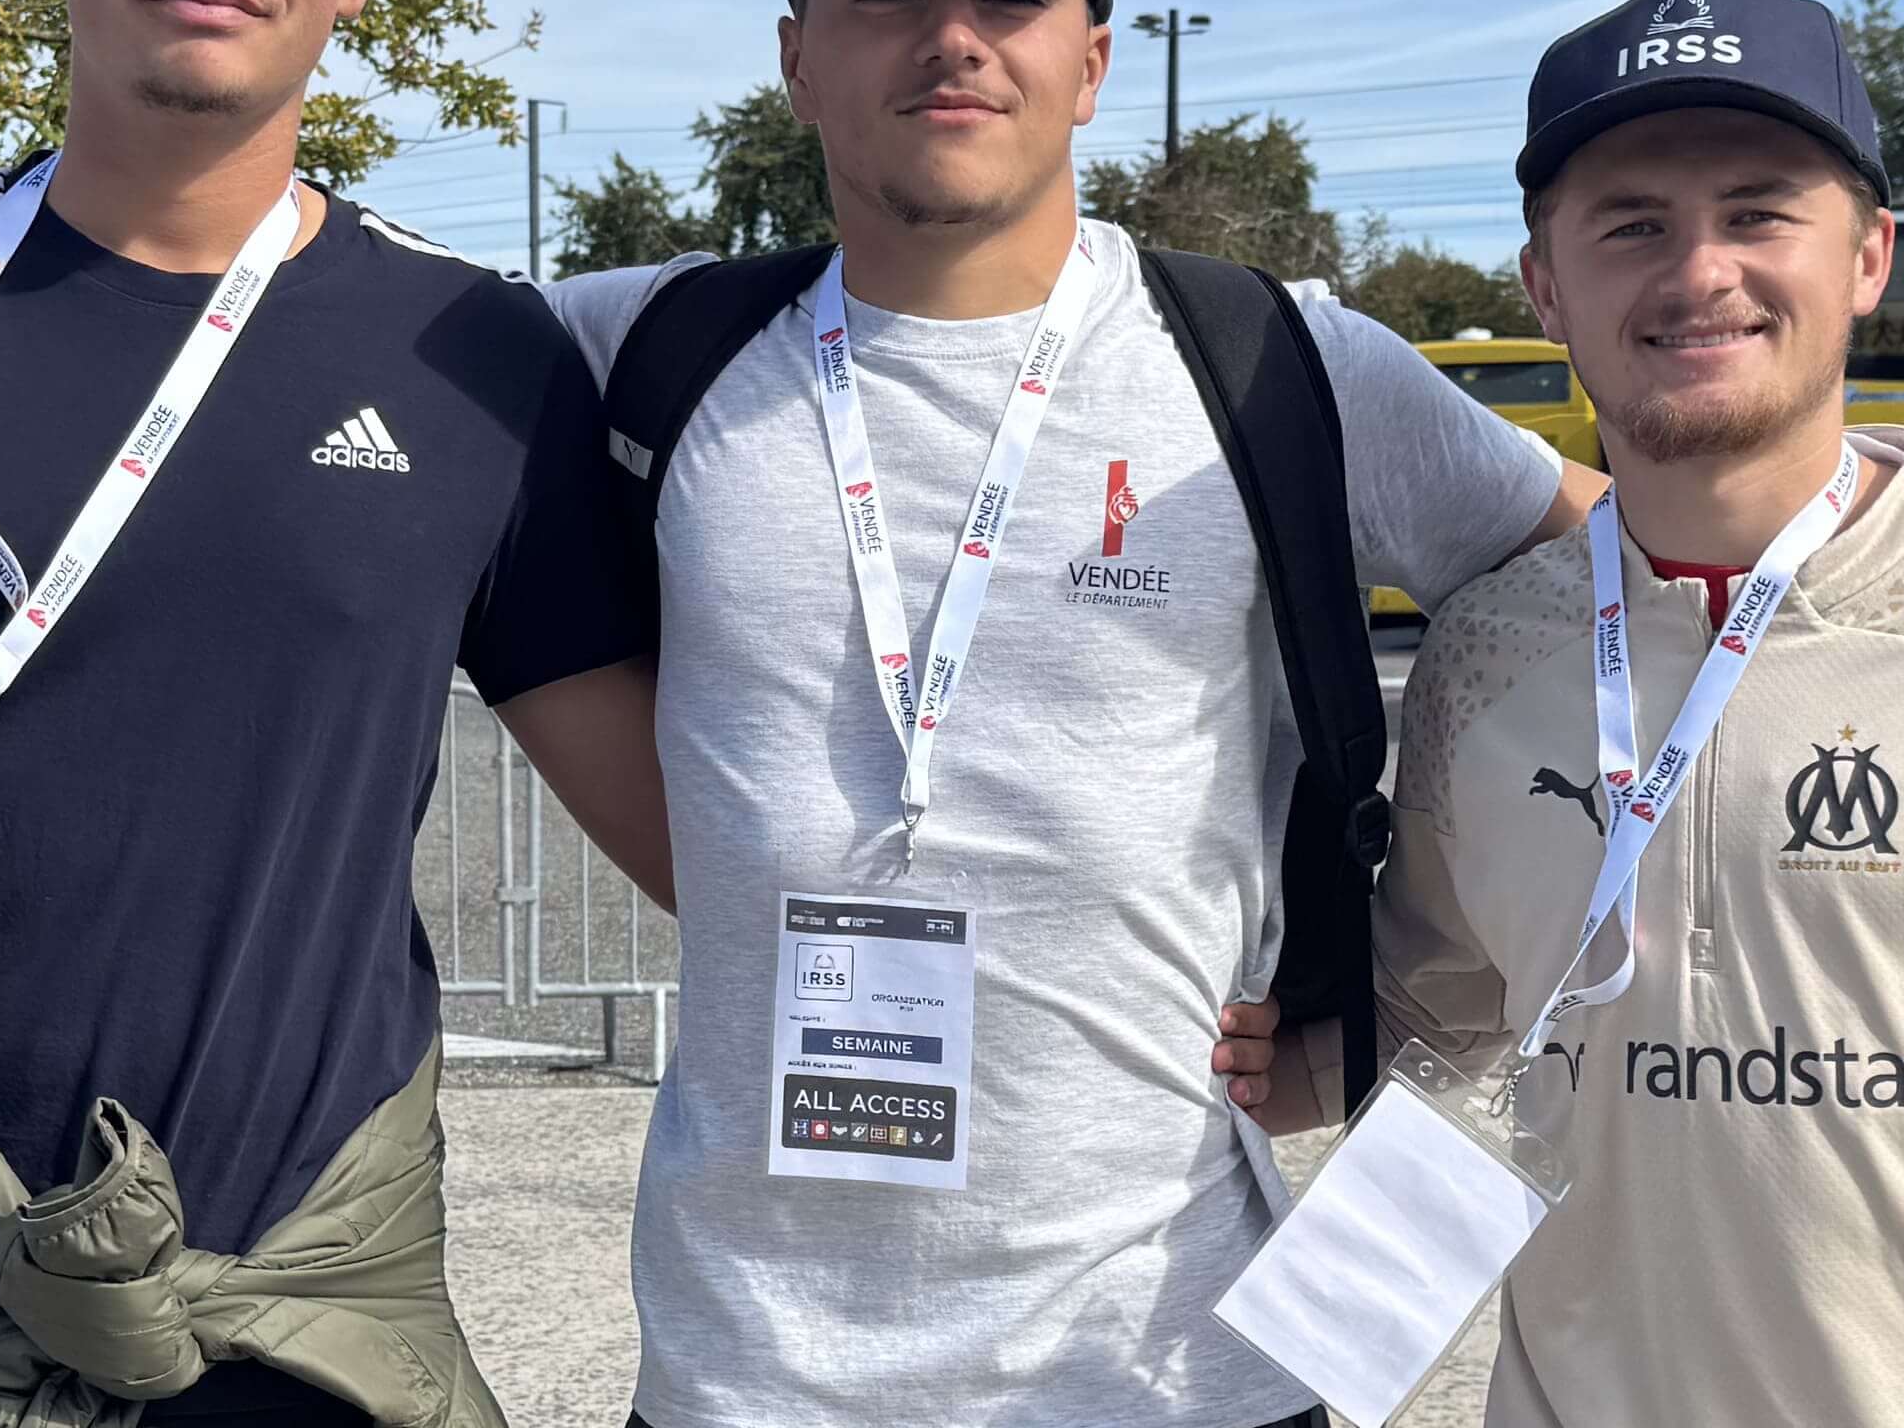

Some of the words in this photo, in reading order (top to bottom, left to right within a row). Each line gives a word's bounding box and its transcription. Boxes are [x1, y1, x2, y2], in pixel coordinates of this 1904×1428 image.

[1617, 34, 1742, 77] IRSS
[830, 339, 850, 393] VENDÉE
[1026, 327, 1059, 377] VENDÉE
[129, 404, 172, 457] VENDÉE
[311, 443, 411, 472] adidas
[859, 497, 882, 555] VENDÉE
[969, 481, 1001, 539] VENDÉE
[37, 554, 78, 607] VENDÉE
[1068, 562, 1171, 593] VENDÉE
[1730, 575, 1772, 633] VENDÉE
[1607, 617, 1622, 676] VENDÉE
[1638, 743, 1681, 800] VENDÉE
[802, 971, 846, 986] IRSS
[832, 1035, 913, 1055] SEMAINE
[794, 1089, 841, 1112] ALL
[849, 1093, 945, 1121] ACCESS
